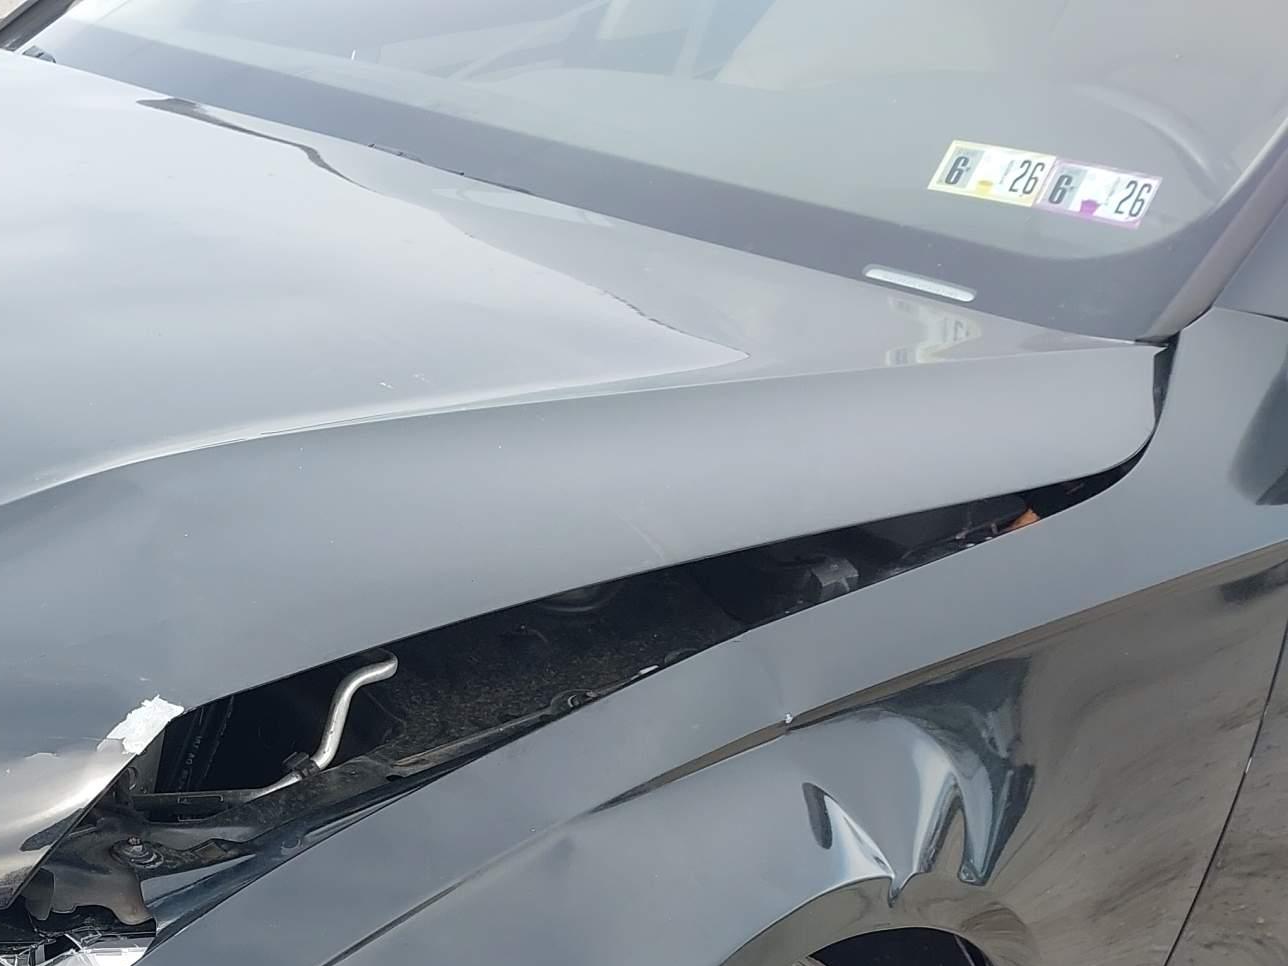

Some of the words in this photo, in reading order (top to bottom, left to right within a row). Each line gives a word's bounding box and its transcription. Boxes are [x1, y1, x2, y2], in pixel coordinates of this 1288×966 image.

[944, 156, 970, 185] 6
[1008, 160, 1045, 195] 26
[1048, 174, 1073, 205] 6
[1114, 180, 1153, 217] 26
